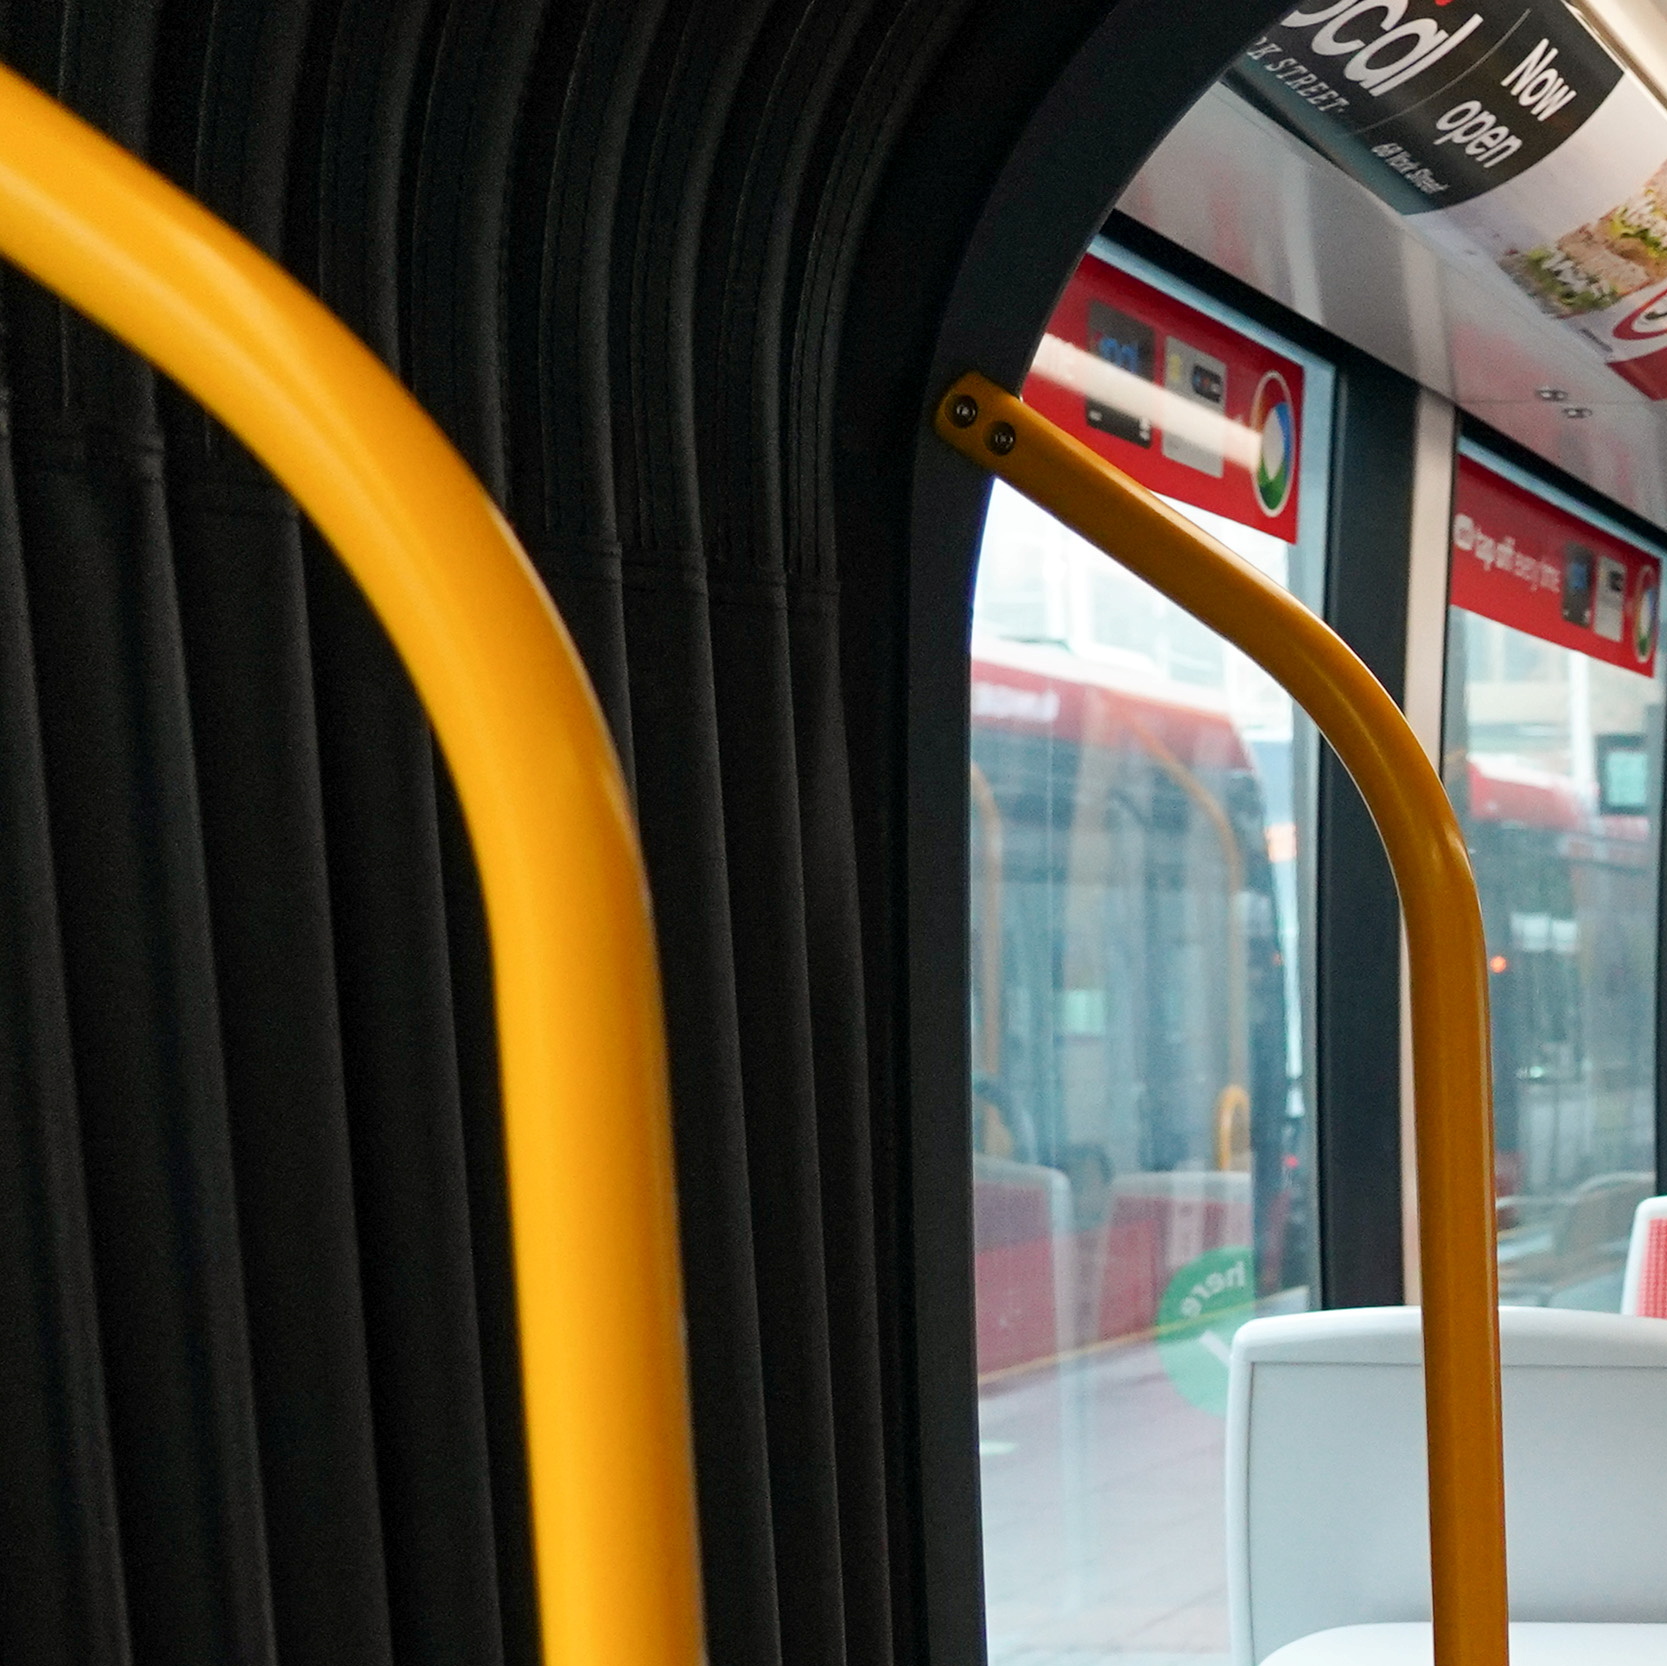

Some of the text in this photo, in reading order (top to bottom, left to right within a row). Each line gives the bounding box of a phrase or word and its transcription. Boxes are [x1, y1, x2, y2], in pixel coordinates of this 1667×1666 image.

[1280, 0, 1484, 97] cal
[1500, 38, 1577, 121] Now
[1263, 58, 1350, 112] STREET
[1435, 99, 1522, 168] open
[1411, 163, 1450, 195] Street
